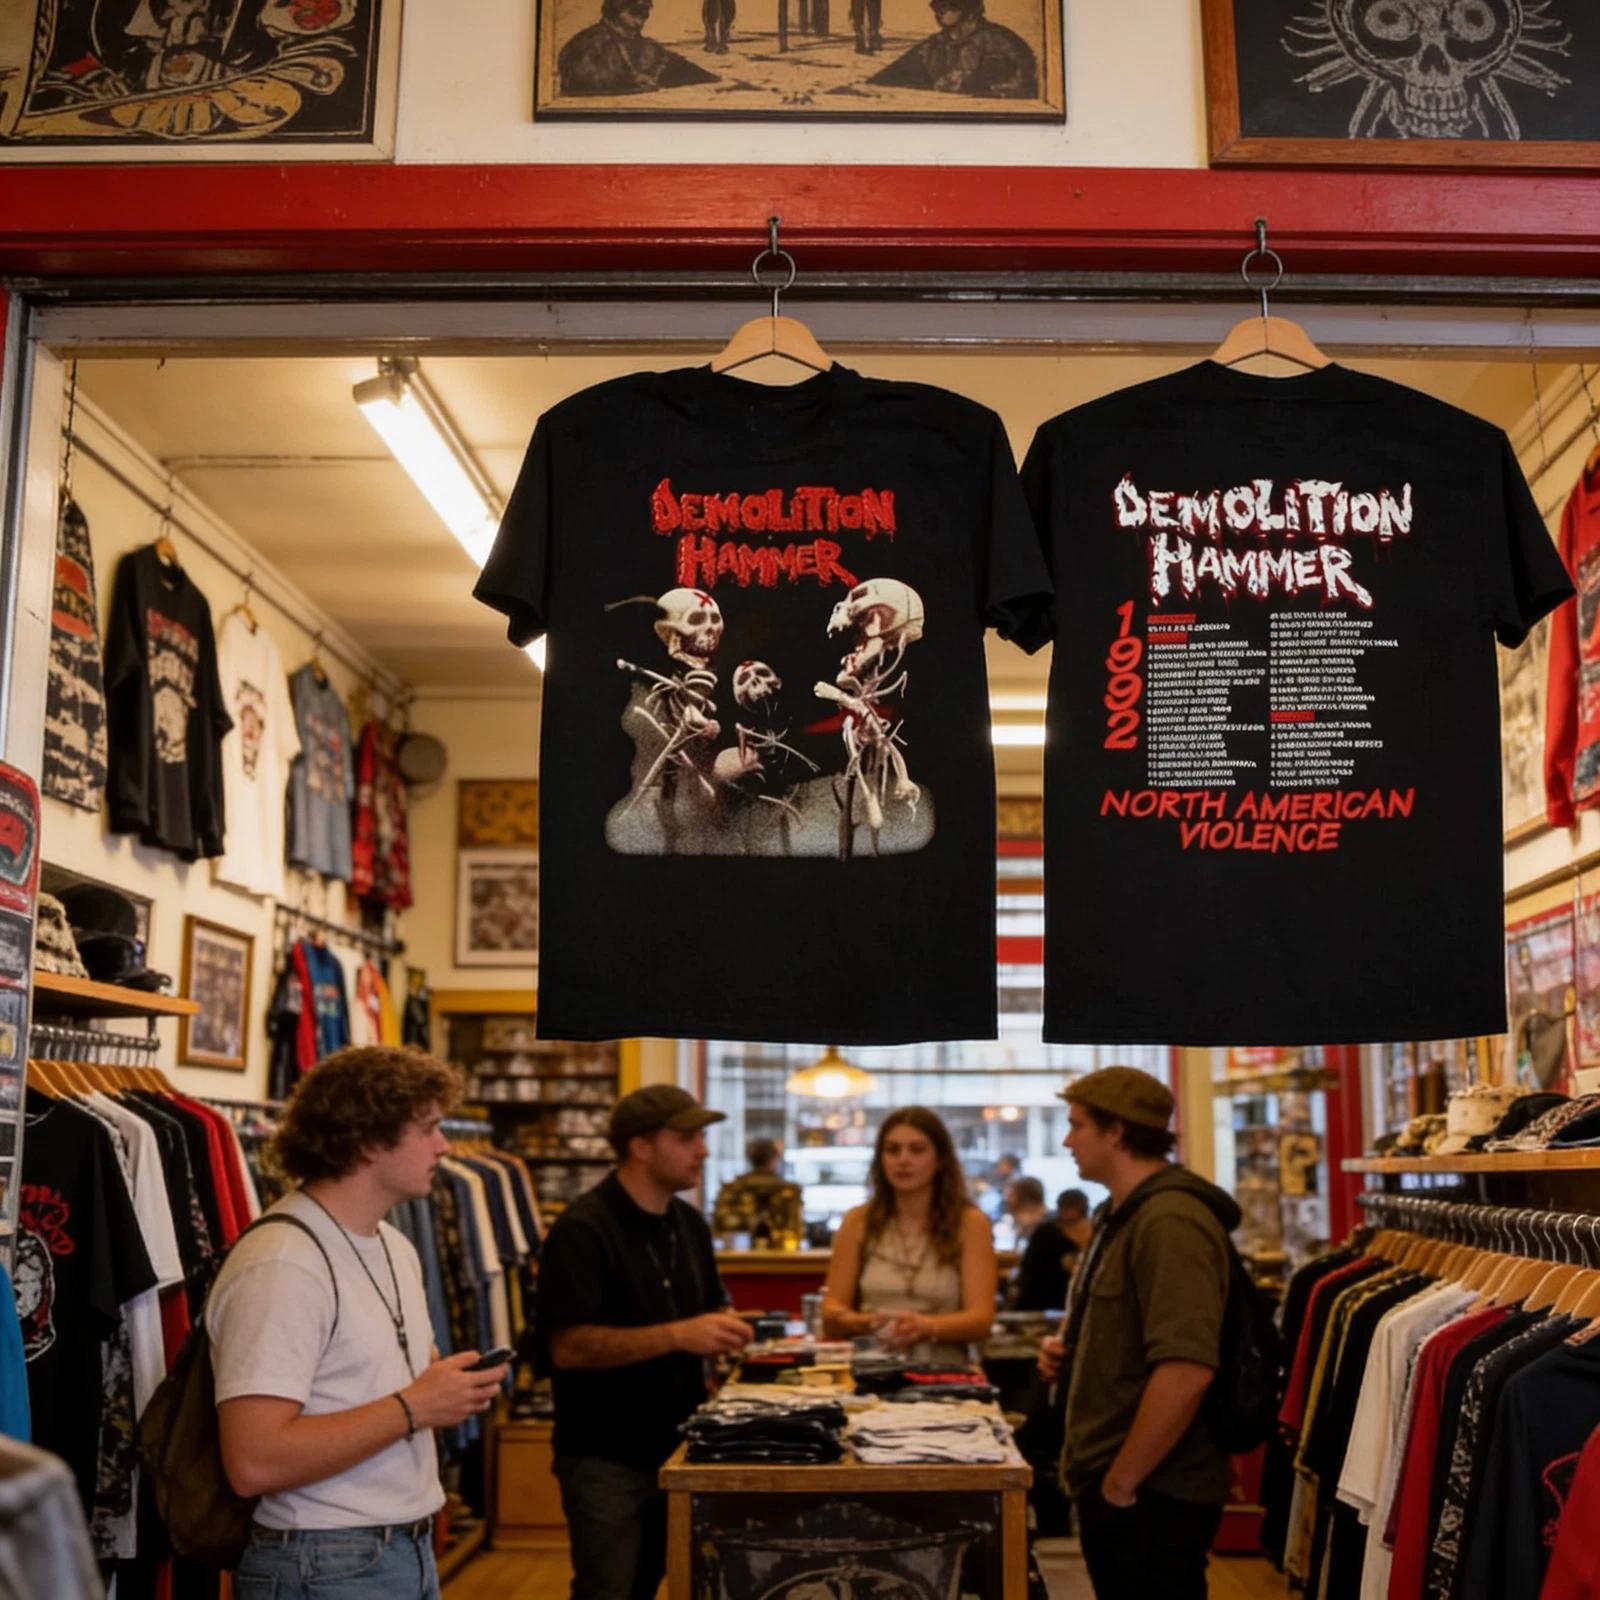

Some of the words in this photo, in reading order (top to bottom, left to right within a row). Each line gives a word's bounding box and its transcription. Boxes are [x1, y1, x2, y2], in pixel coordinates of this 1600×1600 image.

[652, 478, 896, 537] DEMOLITION
[1110, 474, 1414, 541] DEMOLITION
[677, 532, 858, 587] HAMMER
[1150, 533, 1373, 607] HAMMER
[1104, 600, 1143, 750] 1992
[1100, 789, 1226, 819] NORTH
[1232, 788, 1416, 822] AMERICAN
[1180, 822, 1342, 853] VIOLENCE
